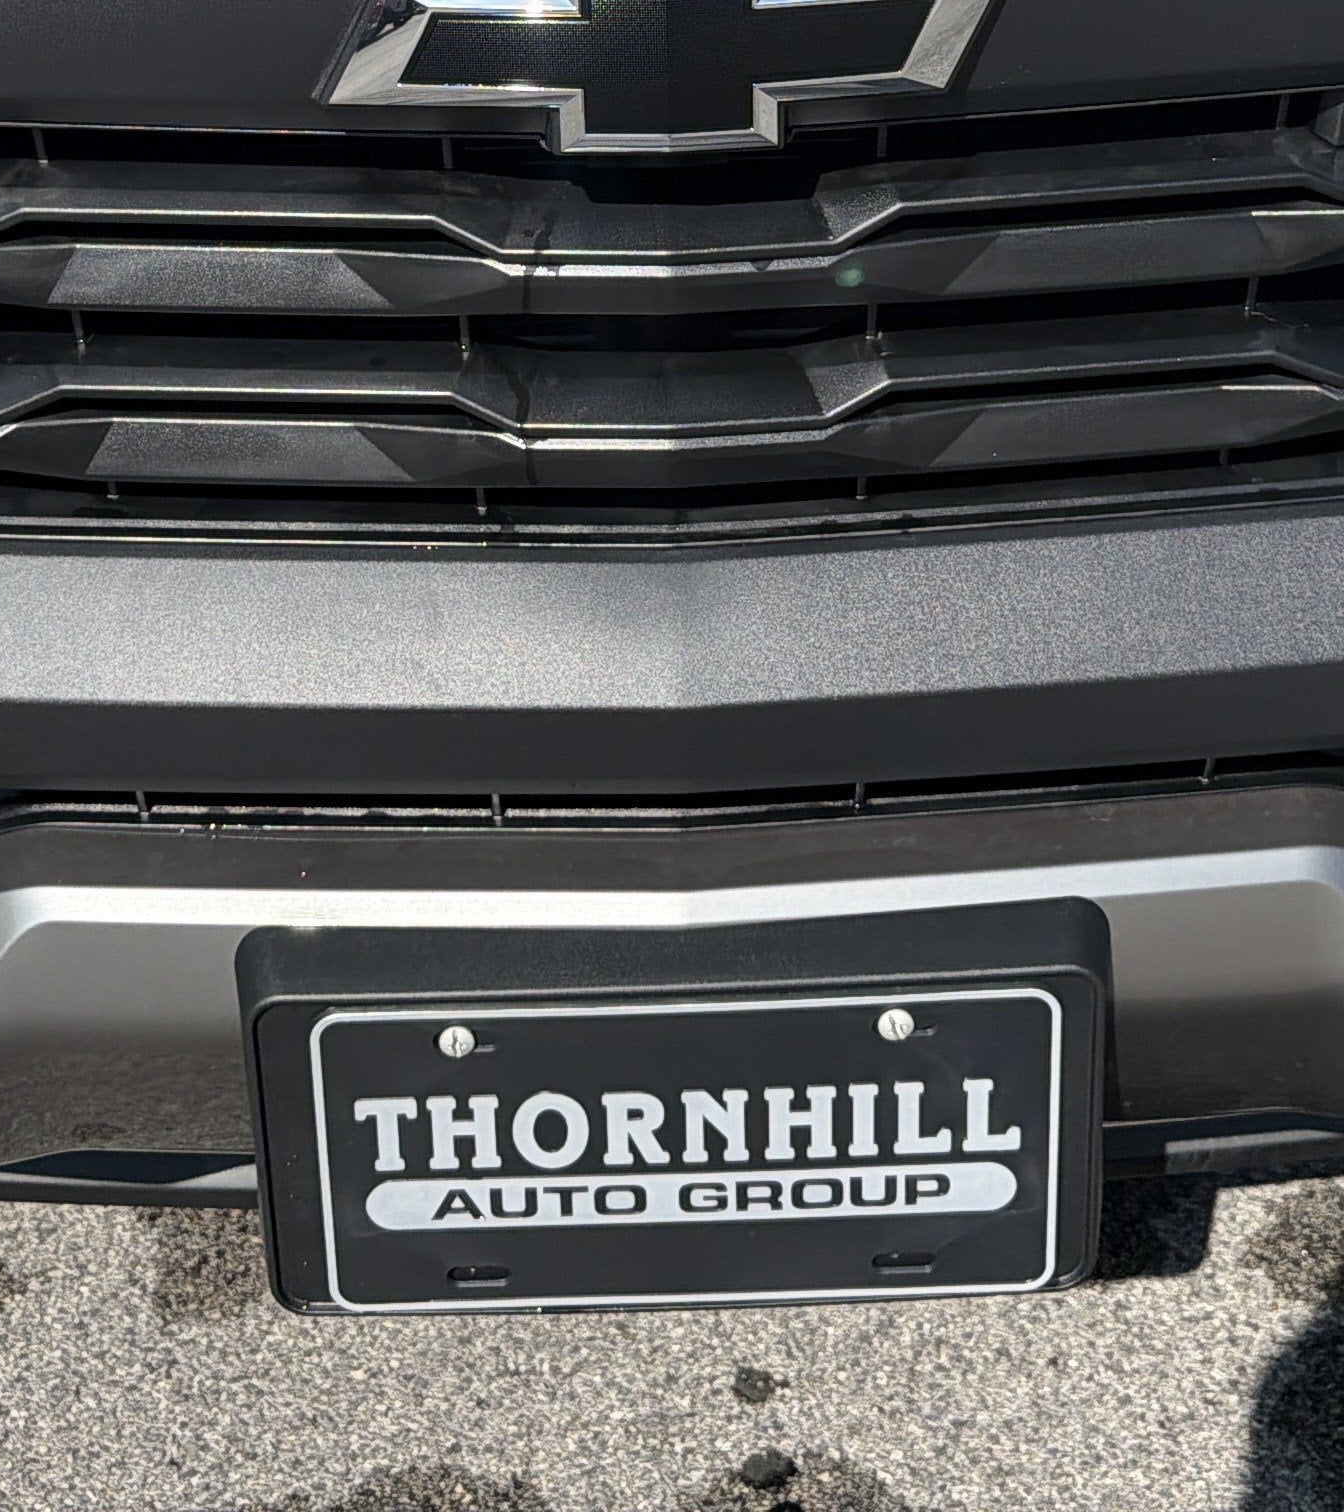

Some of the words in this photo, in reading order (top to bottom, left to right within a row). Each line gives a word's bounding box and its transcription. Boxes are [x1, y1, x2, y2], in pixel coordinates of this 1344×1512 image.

[354, 1078, 1022, 1172] THORNHILL
[432, 1184, 647, 1221] AUTO
[678, 1173, 951, 1213] GROUP
